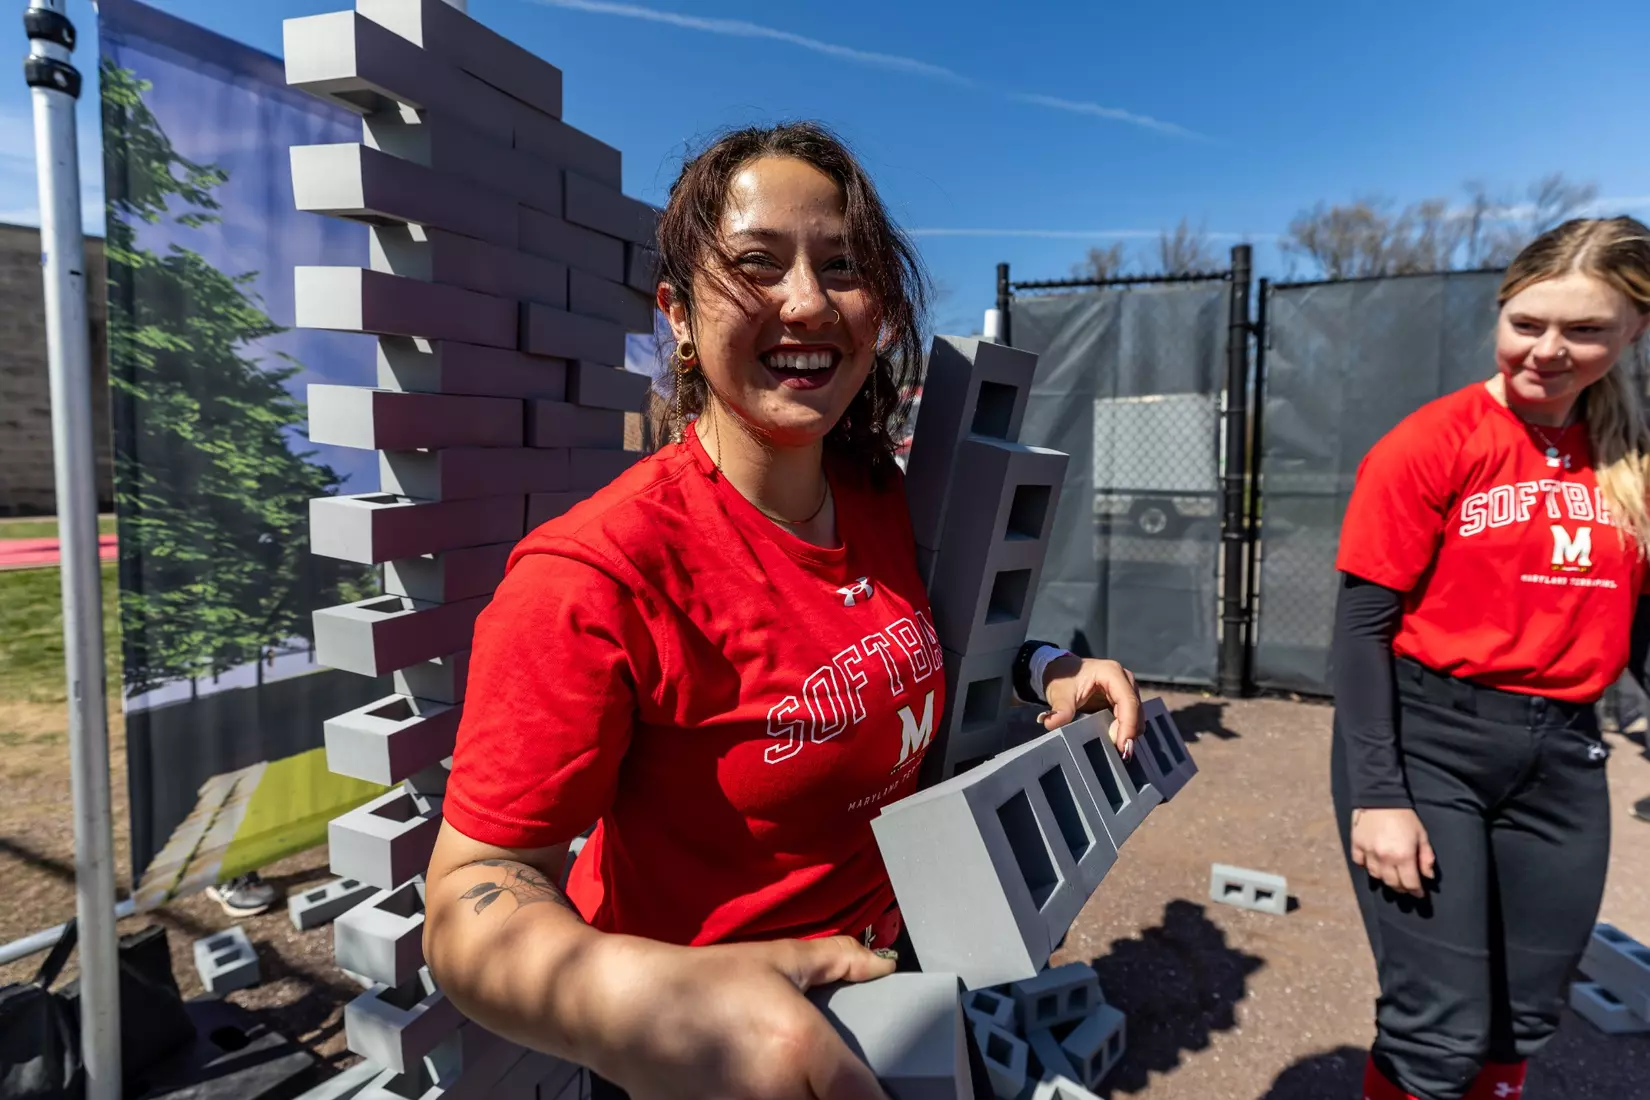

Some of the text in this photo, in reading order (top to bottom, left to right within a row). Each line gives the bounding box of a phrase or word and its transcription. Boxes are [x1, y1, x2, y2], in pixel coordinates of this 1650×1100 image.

[1550, 525, 1592, 566] M
[764, 610, 942, 764] SOFTBA
[895, 690, 934, 768] M
[848, 780, 898, 812] MARYLAND
